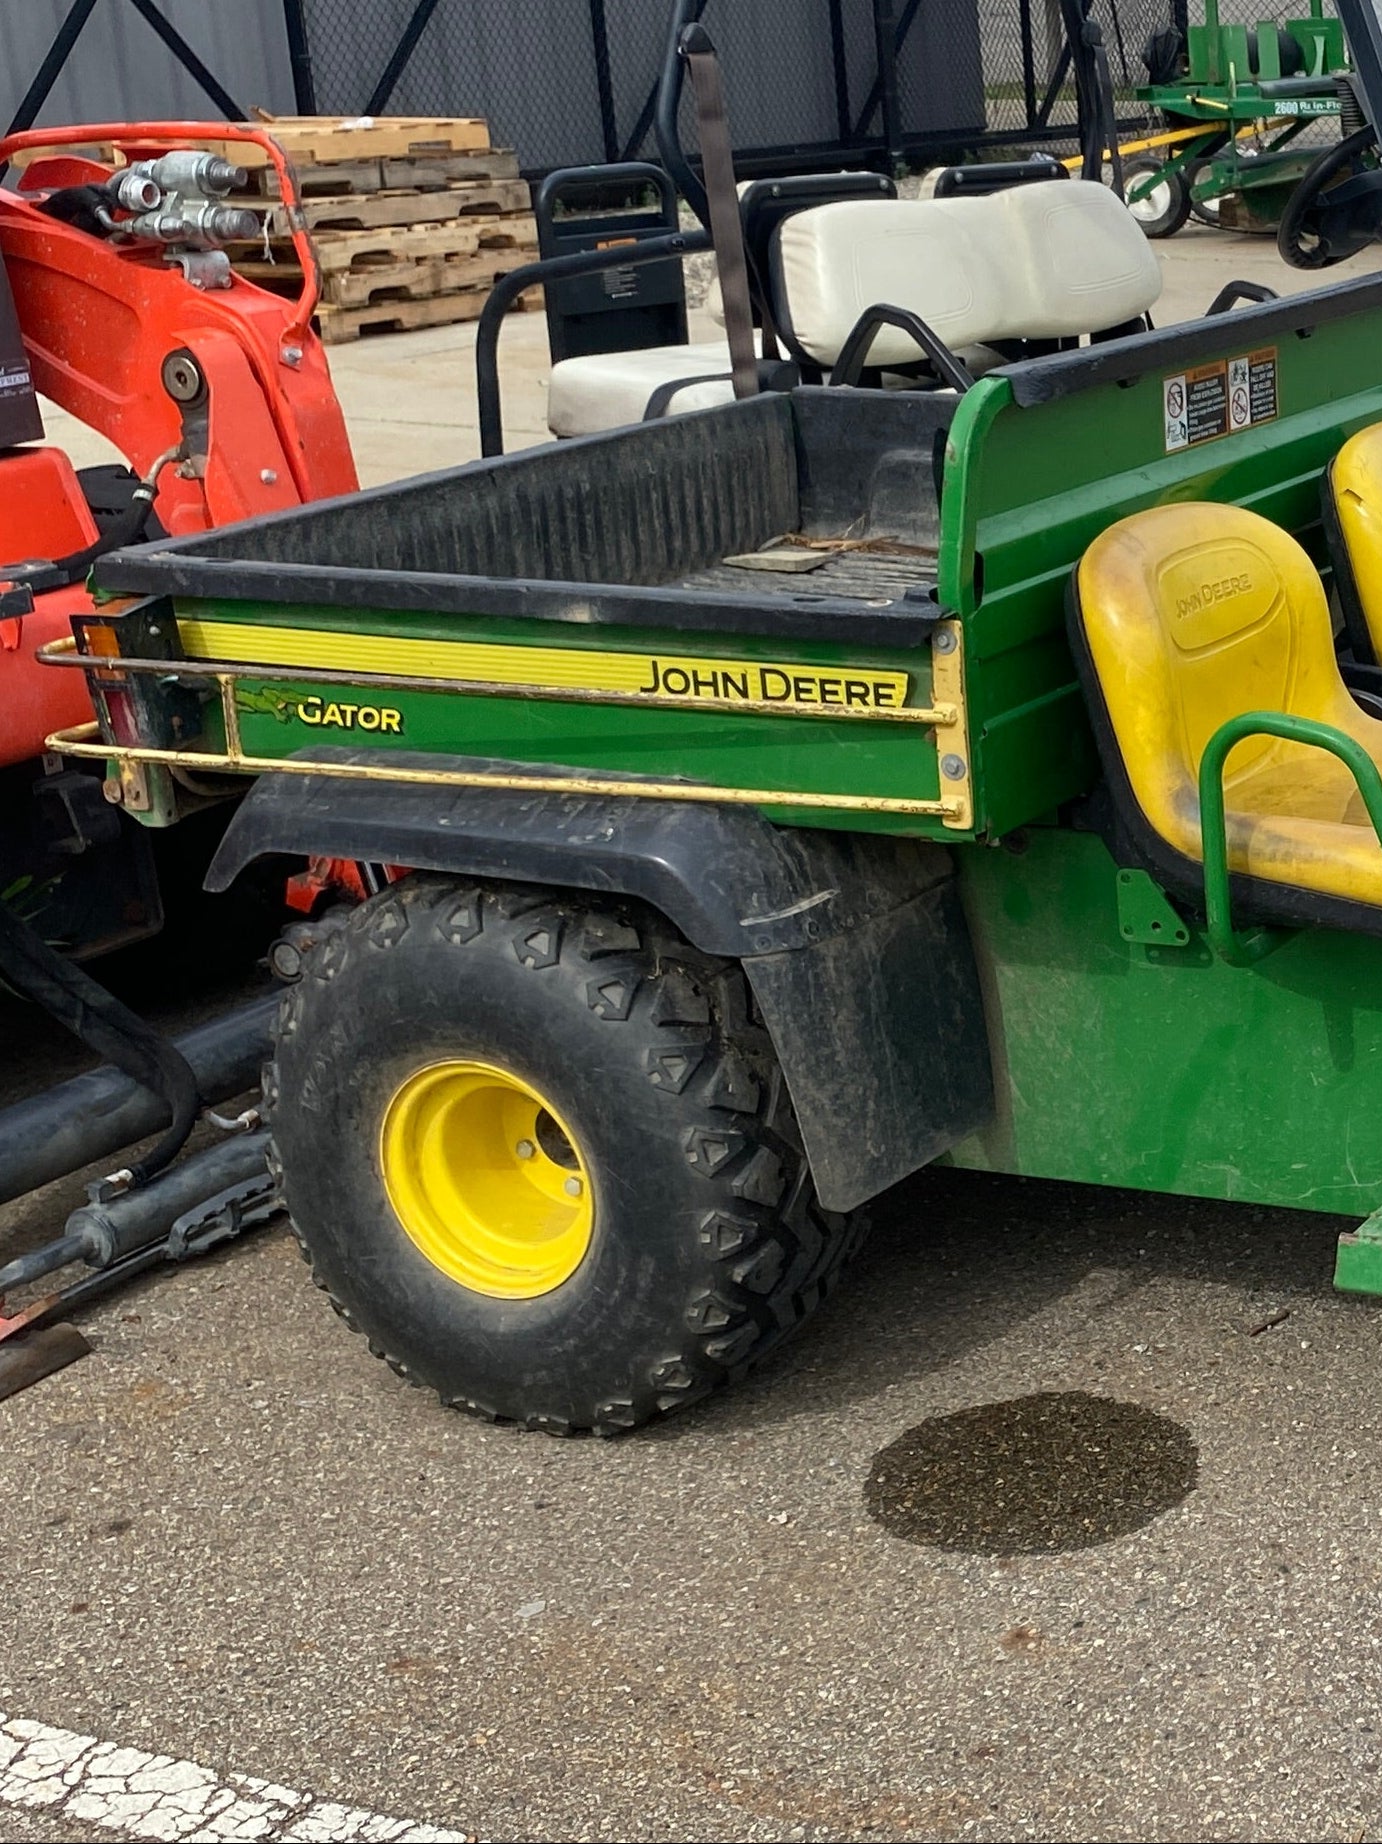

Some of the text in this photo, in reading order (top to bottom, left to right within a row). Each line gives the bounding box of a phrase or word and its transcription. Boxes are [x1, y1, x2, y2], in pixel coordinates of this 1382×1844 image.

[1275, 101, 1298, 115] 2600
[1176, 574, 1253, 619] JOHN DEERE
[640, 660, 897, 708] JOHN DEERE
[298, 696, 401, 732] GATOR
